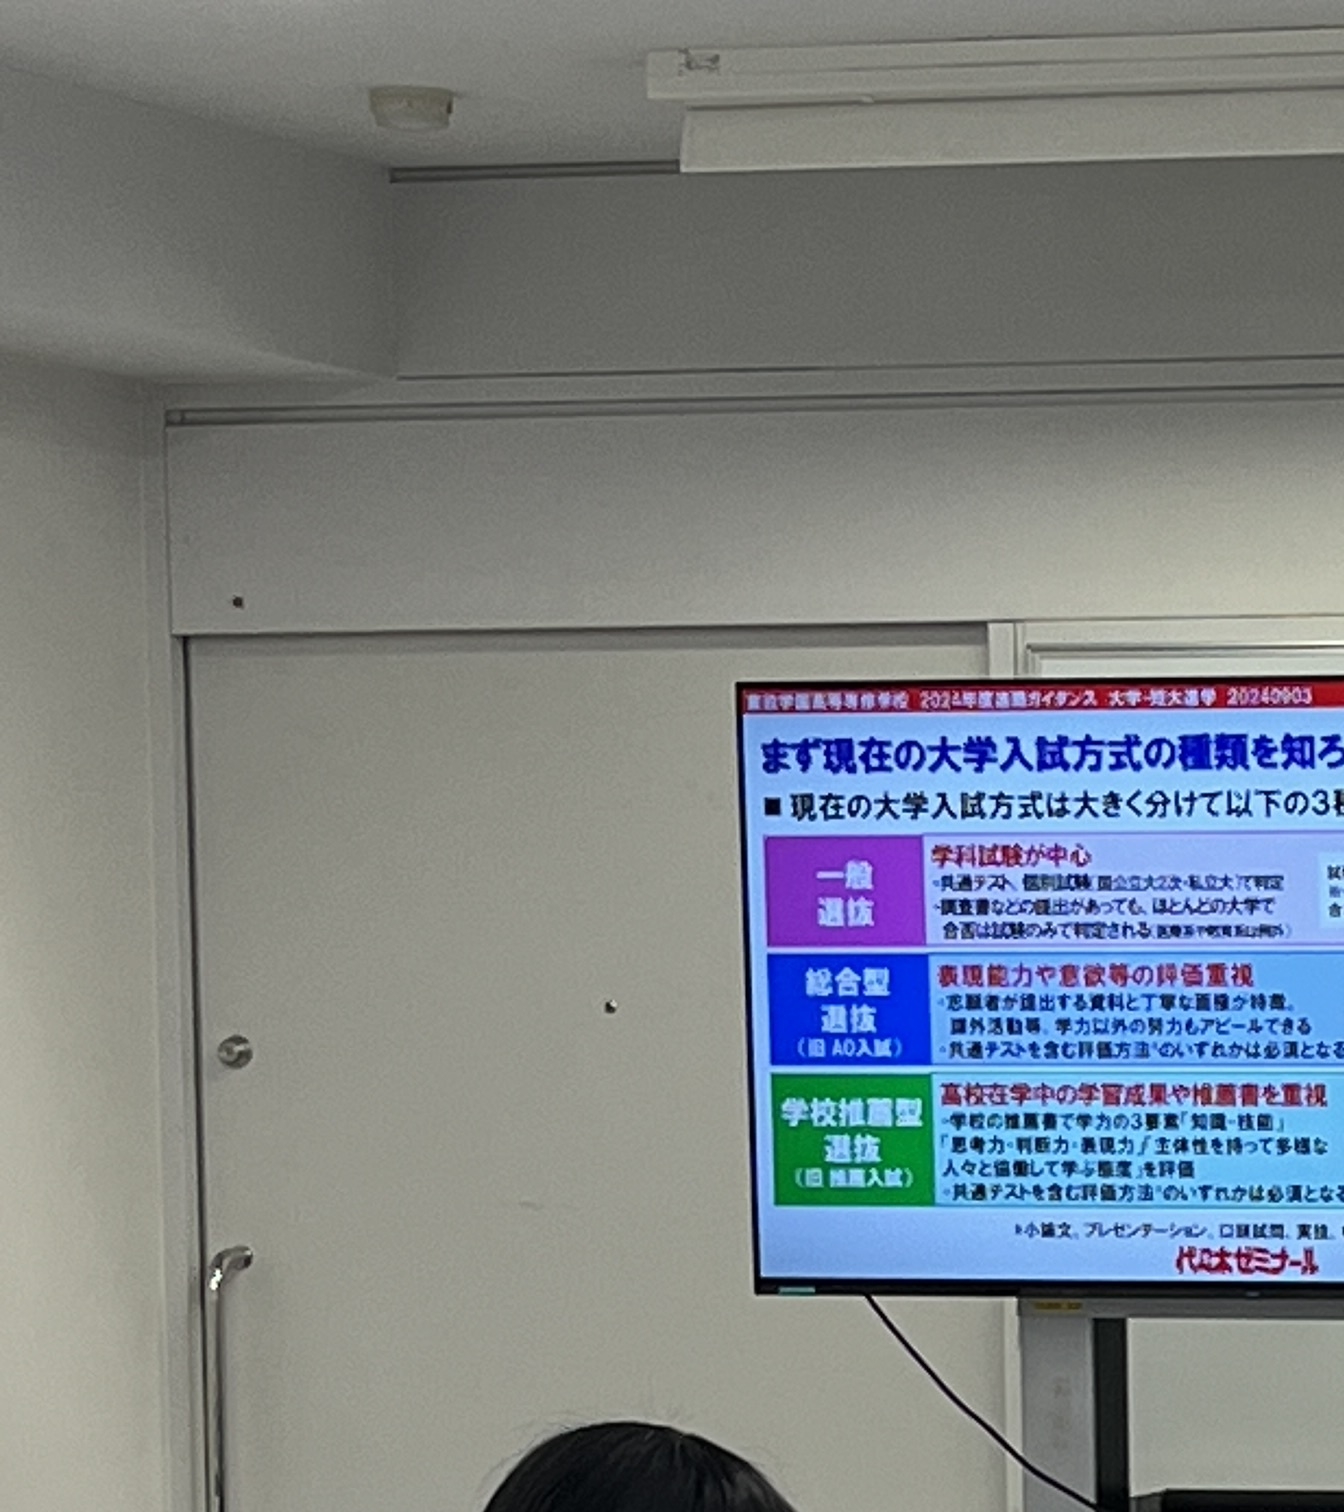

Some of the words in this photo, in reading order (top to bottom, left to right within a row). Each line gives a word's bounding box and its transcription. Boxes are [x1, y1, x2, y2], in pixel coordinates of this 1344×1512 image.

[930, 842, 1093, 869] 学科試験が中心
[815, 859, 875, 892] 一般
[816, 896, 875, 928] 選抜
[804, 966, 891, 997] 総合型
[820, 1003, 878, 1034] 選抜
[780, 1097, 924, 1129] 学校推薦型
[823, 1133, 883, 1164] 選抜
